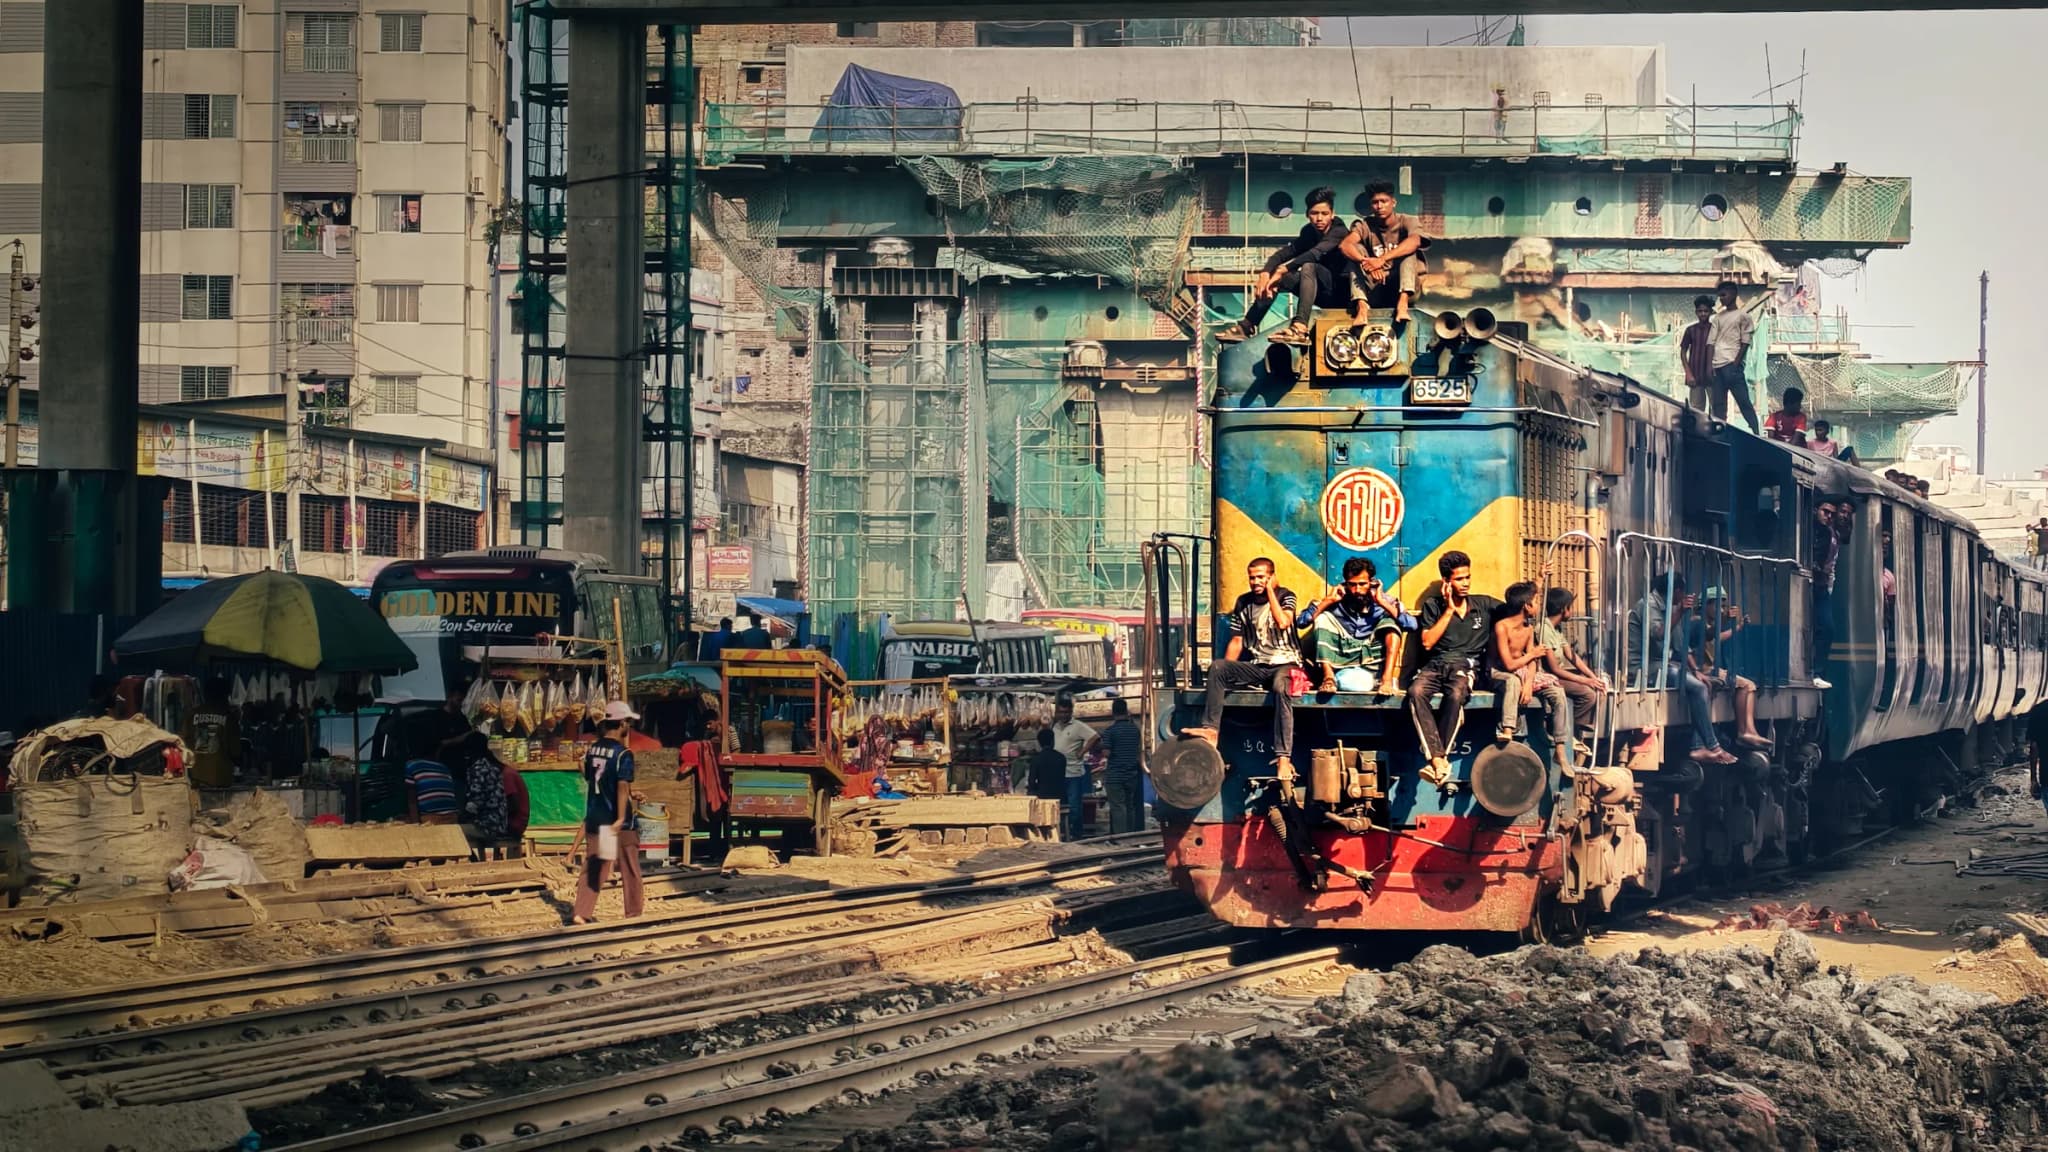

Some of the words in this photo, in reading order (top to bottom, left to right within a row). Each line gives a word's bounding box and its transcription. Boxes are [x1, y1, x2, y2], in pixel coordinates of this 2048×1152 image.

[1415, 380, 1465, 398] 6525
[380, 591, 489, 617] GOLDEN
[494, 591, 561, 617] LINE
[438, 619, 463, 632] Con
[463, 619, 514, 633] Service
